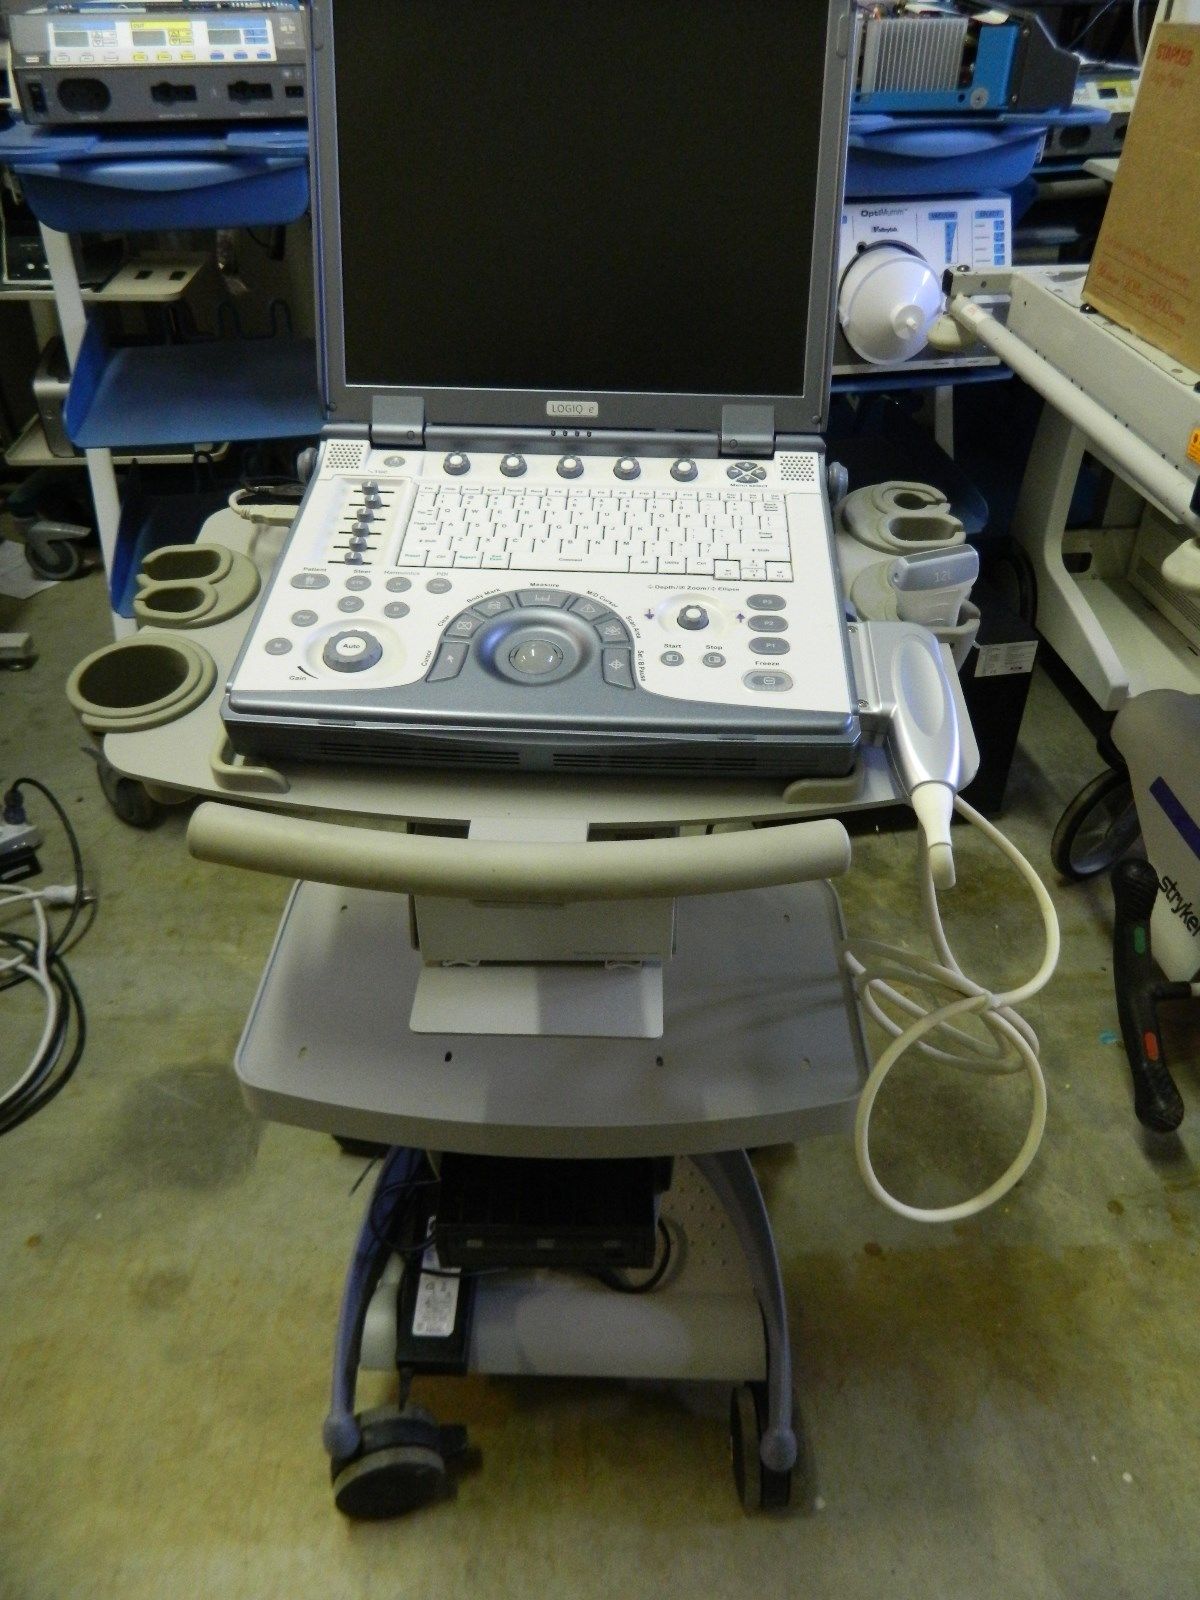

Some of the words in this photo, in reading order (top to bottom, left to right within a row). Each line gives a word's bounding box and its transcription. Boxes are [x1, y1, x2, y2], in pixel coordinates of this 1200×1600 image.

[552, 404, 583, 414] LOGIQ
[466, 592, 484, 603] Body
[421, 650, 433, 667] Cursor
